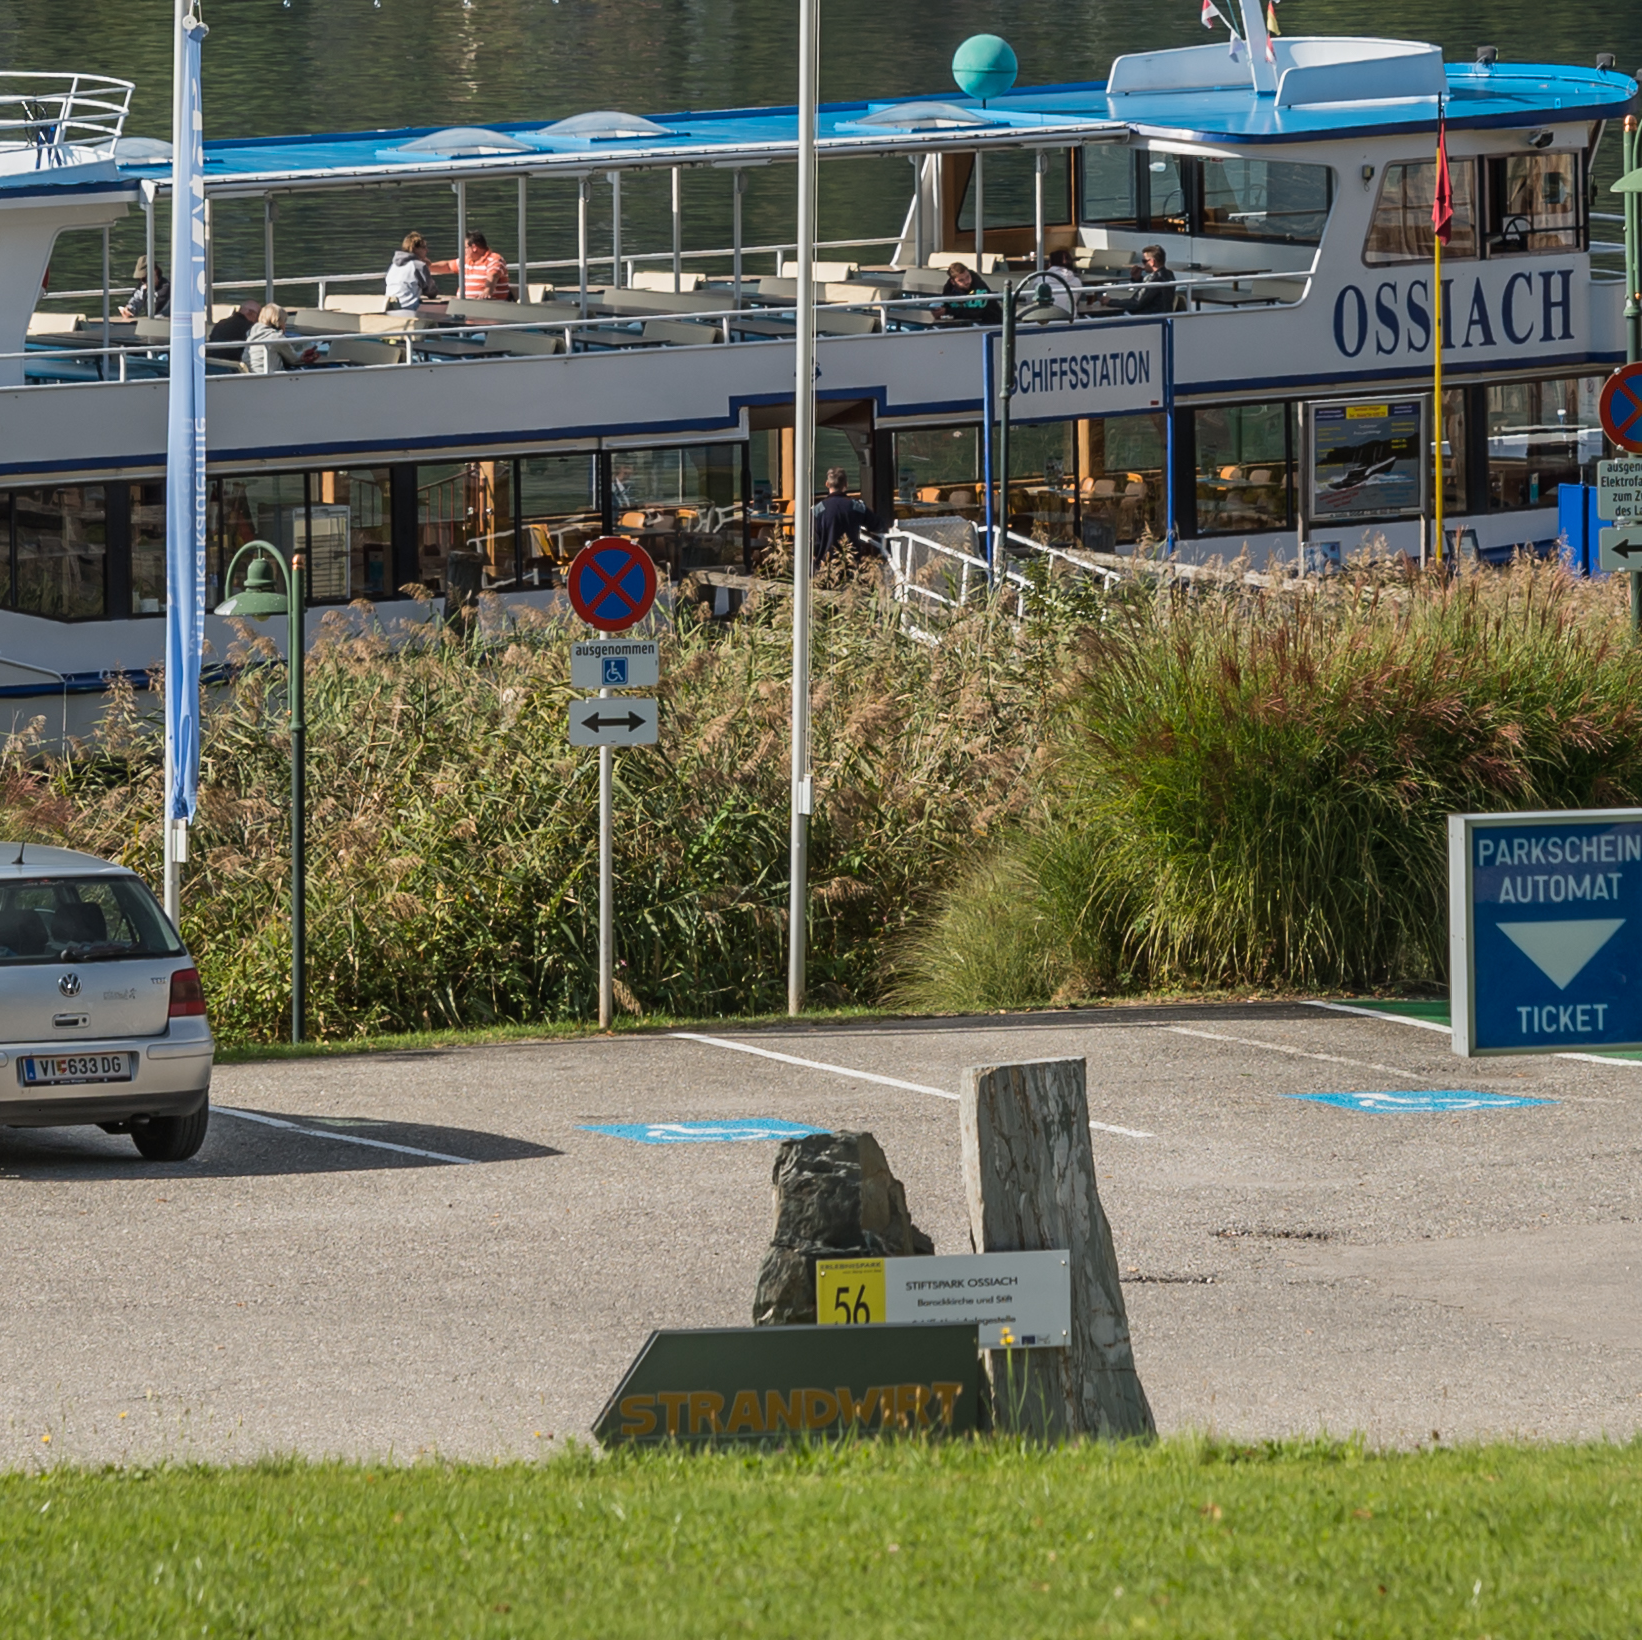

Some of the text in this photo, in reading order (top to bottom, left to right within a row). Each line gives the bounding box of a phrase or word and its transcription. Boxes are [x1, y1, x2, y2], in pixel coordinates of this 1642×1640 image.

[1333, 269, 1575, 358] OSSIACH
[1613, 493, 1632, 502] zum
[1615, 506, 1631, 516] des
[575, 643, 655, 658] ausgenommen
[1478, 834, 1642, 866] PARKSCHEIN
[1499, 873, 1623, 904] AUTOMAT
[1517, 1004, 1609, 1034] TICKET
[39, 1056, 122, 1077] VI 633 DG
[905, 1276, 1019, 1292] STIFTSPARK OSSIACH
[835, 1284, 871, 1325] 56
[917, 1294, 1013, 1307] Barockkirche und Stift
[619, 1382, 963, 1435] STRANDWIRT
